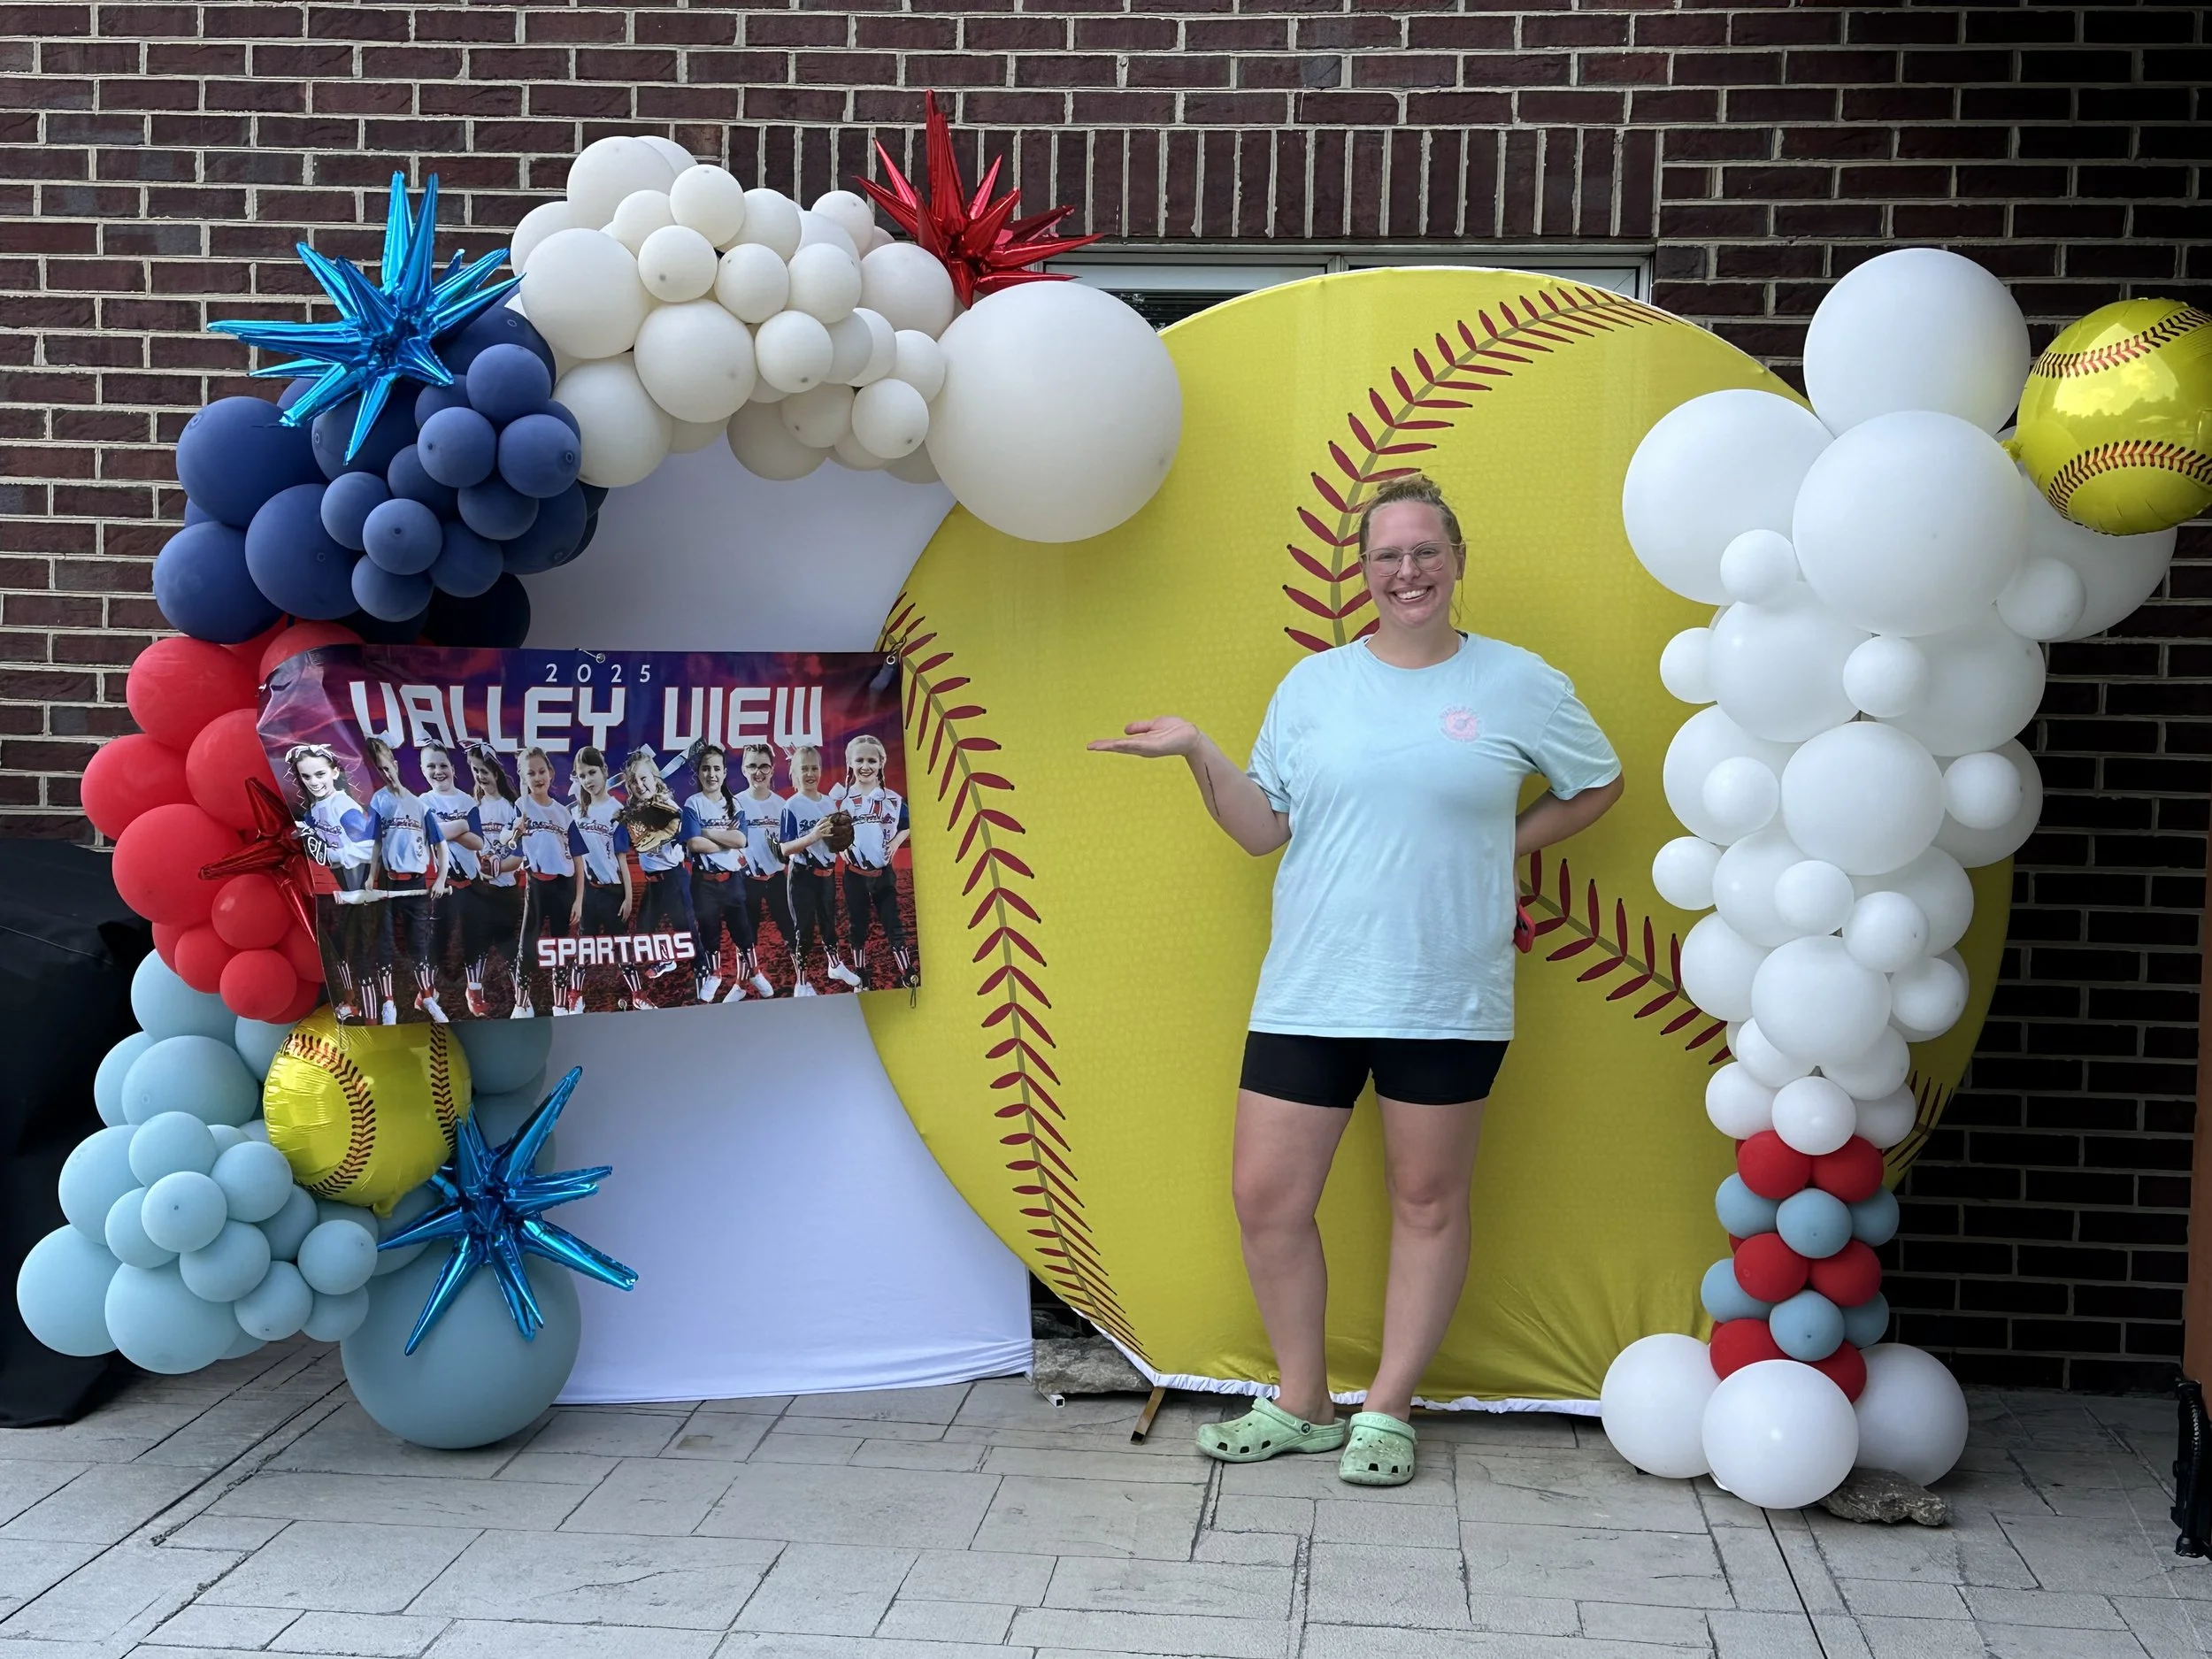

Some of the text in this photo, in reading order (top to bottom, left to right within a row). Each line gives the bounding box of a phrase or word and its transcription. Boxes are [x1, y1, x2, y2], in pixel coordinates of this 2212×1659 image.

[545, 664, 651, 683] 2025
[349, 680, 824, 752] VALLEY VIEW
[537, 932, 695, 967] SPARTANS
